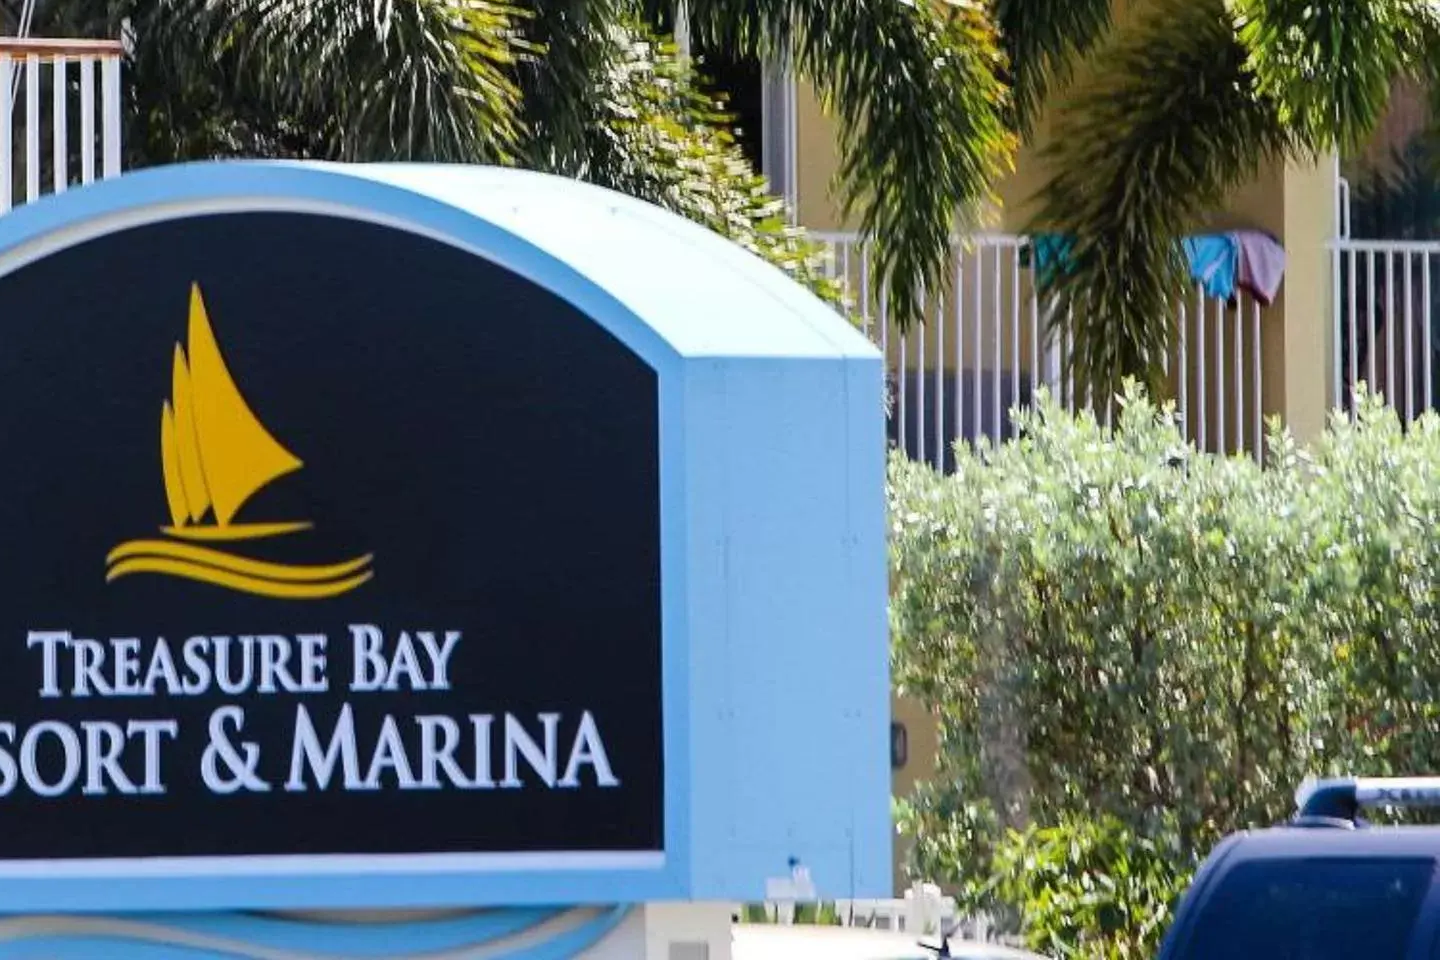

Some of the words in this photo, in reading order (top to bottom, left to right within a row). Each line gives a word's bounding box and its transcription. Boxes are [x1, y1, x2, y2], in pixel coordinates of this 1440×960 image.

[26, 630, 329, 697] TREASURE
[349, 623, 460, 692] BAY
[200, 705, 270, 794] &
[284, 702, 619, 791] MARINA
